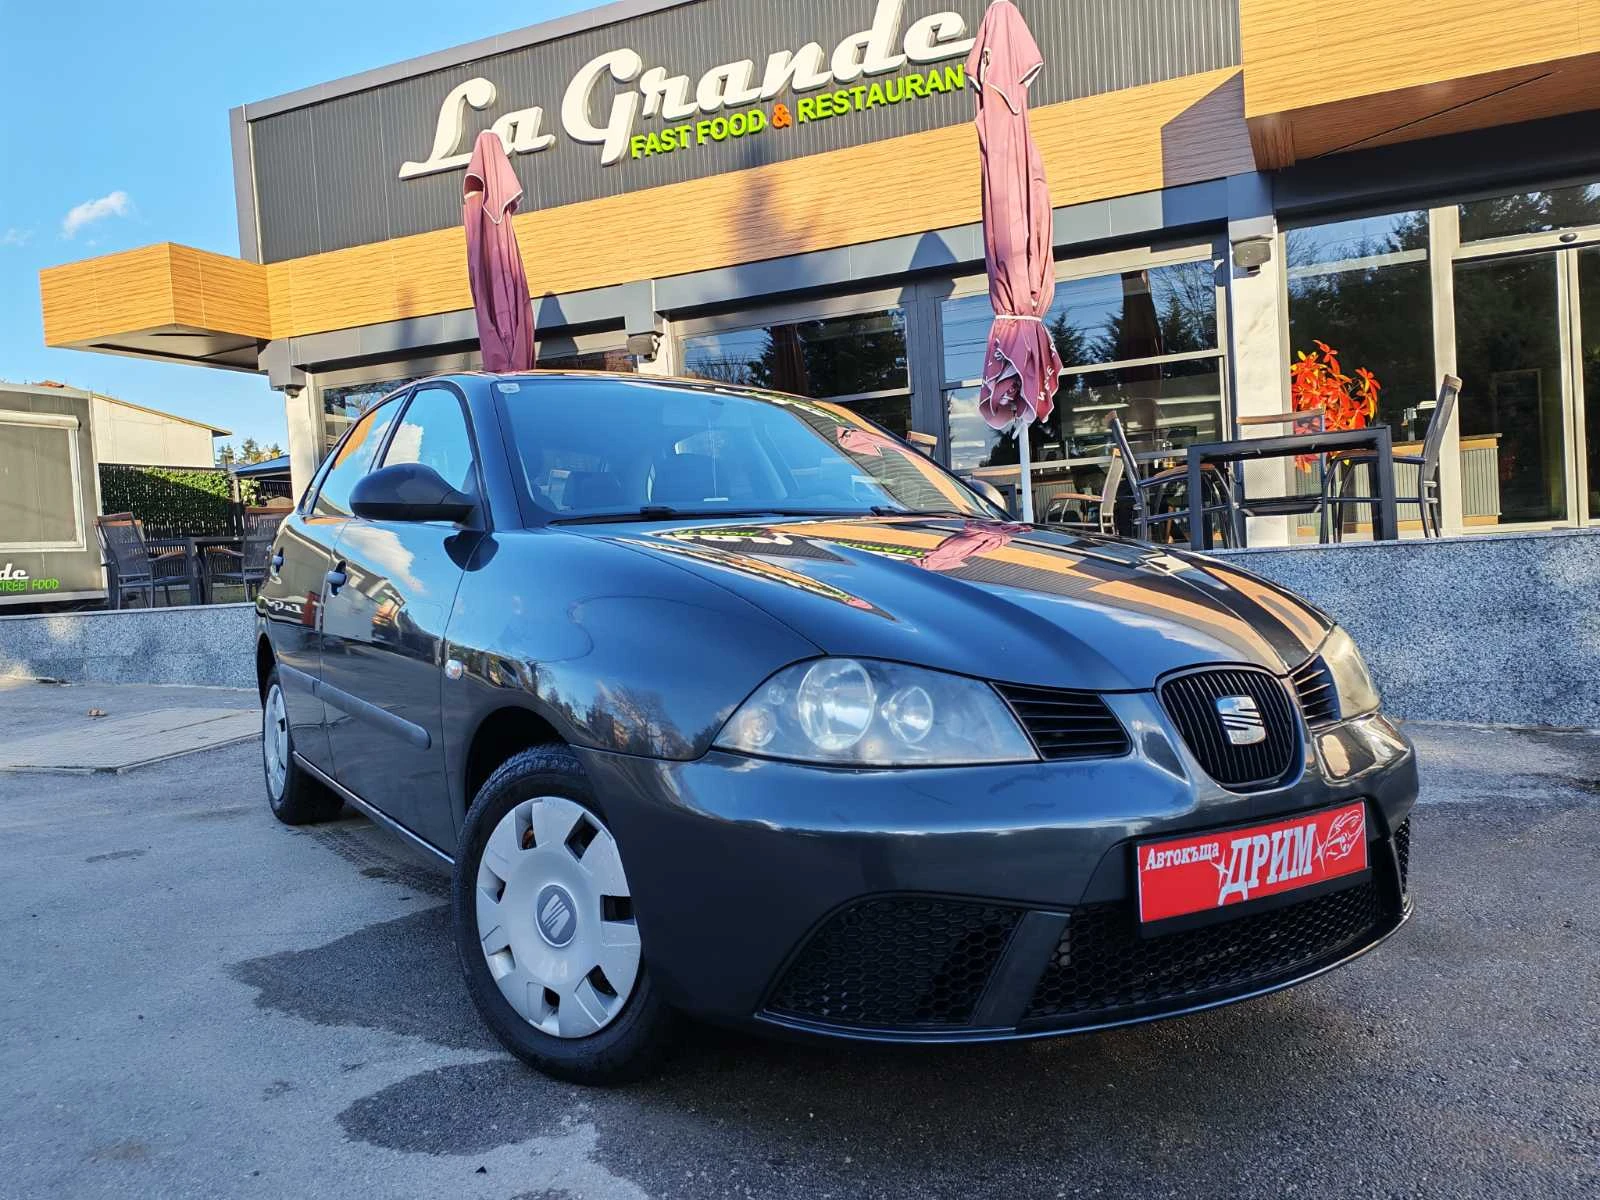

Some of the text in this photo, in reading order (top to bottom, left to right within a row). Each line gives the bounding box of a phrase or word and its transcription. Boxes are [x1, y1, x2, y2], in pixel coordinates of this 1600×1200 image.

[399, 0, 974, 180] La Grande
[630, 63, 966, 159] FAST FOOD & RESTAURAN
[32, 577, 60, 591] FOOD
[1144, 823, 1316, 906] Автокъща ДРИМ
